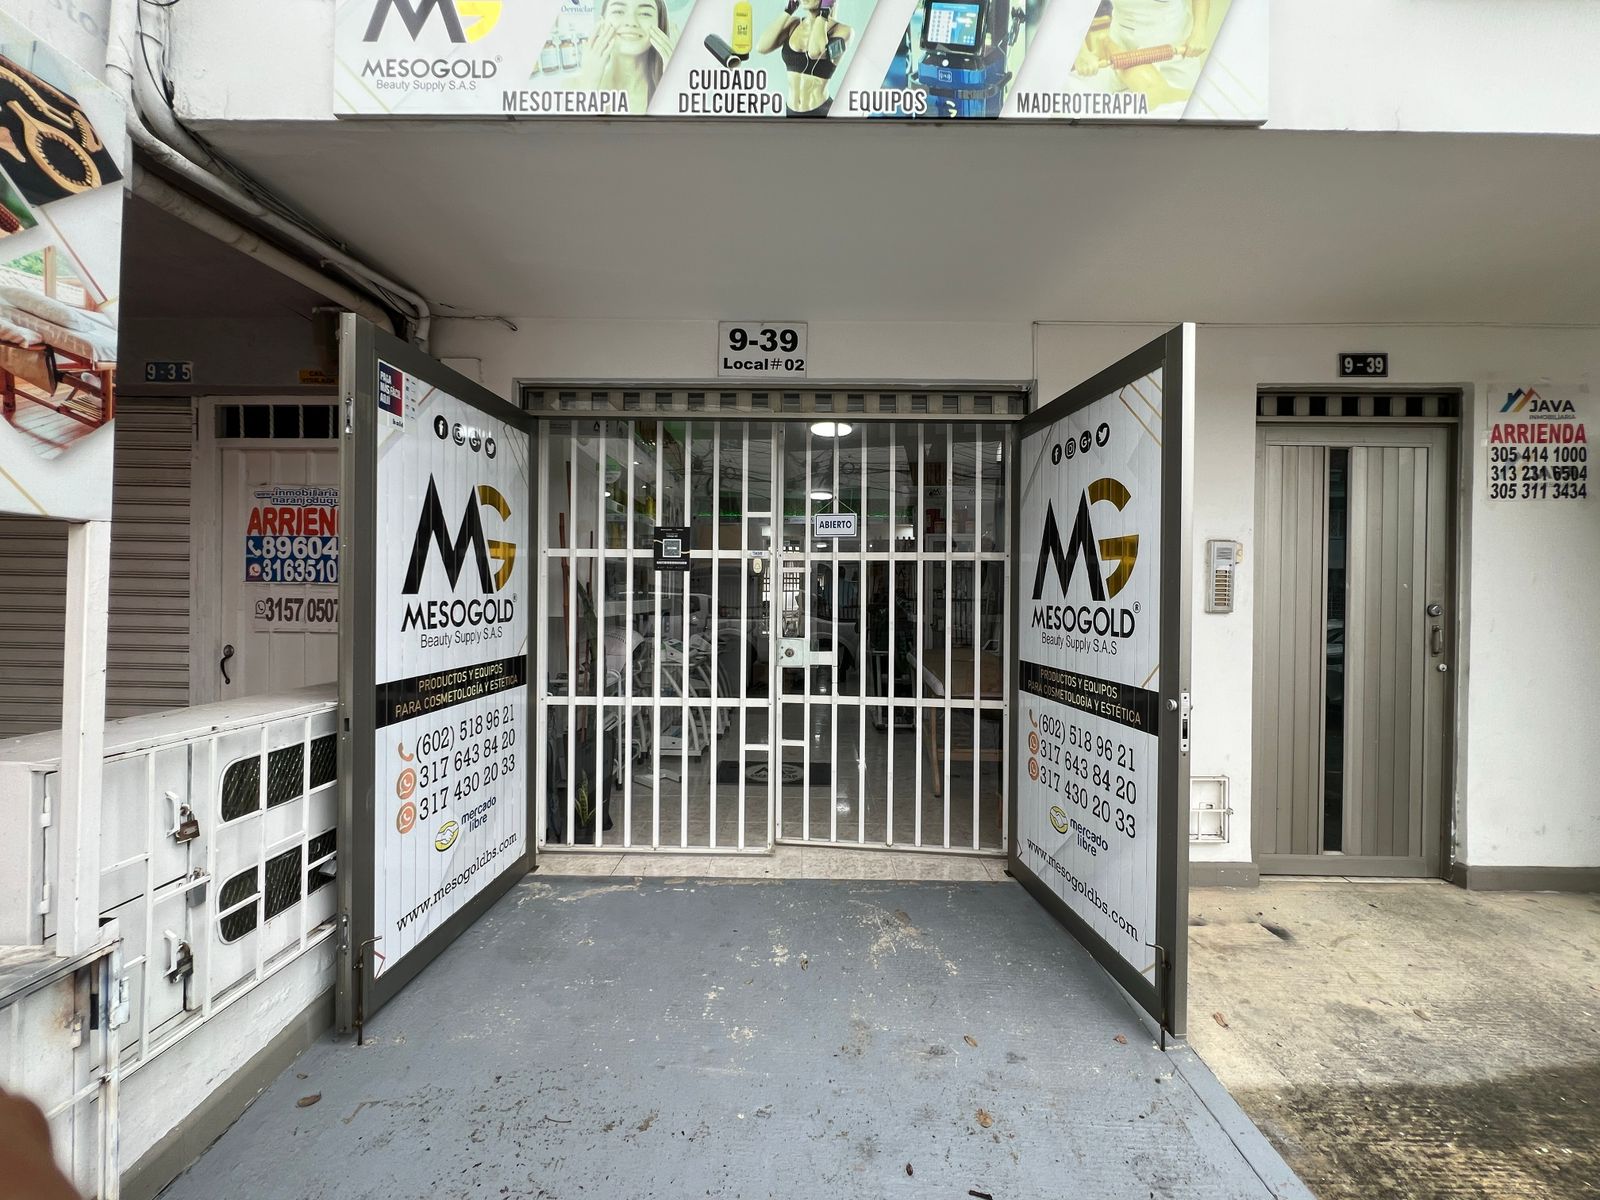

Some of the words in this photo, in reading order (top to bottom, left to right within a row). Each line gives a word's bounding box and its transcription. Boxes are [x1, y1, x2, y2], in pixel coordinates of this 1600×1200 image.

[376, 80, 410, 92] Beauty
[413, 80, 446, 92] Supply
[689, 70, 767, 90] CUIDADO
[502, 91, 629, 113] MESOTERAPIA
[849, 91, 926, 113] EQUIPOS
[1017, 93, 1148, 115] MADEROTERAPIA
[729, 328, 799, 352] 9-39
[1529, 400, 1576, 412] JAVA
[1490, 423, 1587, 444] ARRIENDA
[1490, 446, 1517, 462] 305
[1522, 446, 1549, 462] 414
[1553, 446, 1587, 462] 1000
[1491, 465, 1517, 481] 313
[1521, 465, 1547, 481] 231
[1552, 465, 1587, 481] 6504
[1490, 483, 1517, 499] 305
[1521, 483, 1547, 499] 311
[1552, 483, 1587, 499] 3434
[247, 507, 339, 536] ARRIEN
[819, 519, 852, 530] ABIERTO
[420, 631, 453, 649] Beauty
[454, 628, 482, 645] Supply
[1041, 632, 1064, 650] Beauty
[1065, 635, 1091, 653] Supply
[418, 671, 467, 692] PRODUCTOS
[469, 669, 475, 680] Y
[474, 663, 503, 680] EQUIPOS
[1040, 668, 1077, 687] PRODUCTOS
[1077, 678, 1083, 688] Y
[1083, 680, 1118, 699] EQUIPOS
[395, 700, 422, 718] PARA
[424, 681, 484, 709] COSMETOLOGÍA
[484, 682, 489, 692] Y
[1027, 680, 1043, 692] PARA
[1043, 684, 1093, 709] COSMETOLOGÍA
[1094, 700, 1100, 711] Y
[1100, 701, 1142, 725] ESTÉTICA
[416, 726, 455, 763] (602)
[460, 715, 483, 741] 518
[486, 708, 500, 731] 96
[502, 704, 515, 724] 21
[1038, 713, 1066, 745] (602)
[1069, 725, 1092, 752] 518
[1096, 735, 1113, 761] 96
[1117, 744, 1136, 772] 21
[419, 757, 449, 788] 317
[454, 743, 480, 771] 643
[483, 738, 498, 758] 84
[502, 728, 516, 749] 20
[1040, 740, 1061, 767] 317
[1064, 751, 1089, 780] 643
[1092, 764, 1111, 791] 84
[1116, 775, 1137, 805] 20
[419, 786, 449, 821] 317
[454, 772, 480, 801] 430
[483, 763, 498, 784] 20
[502, 754, 516, 776] 33
[461, 796, 497, 825] mercado
[1040, 765, 1061, 793] 317
[1064, 779, 1088, 809] 430
[1092, 795, 1111, 823] 20
[1115, 808, 1136, 839] 33
[469, 813, 488, 833] libre
[1070, 817, 1109, 852] mercado
[1077, 833, 1097, 857] libre
[396, 831, 518, 932] www.mesogoldbs.com
[1026, 838, 1139, 942] www.mesogoldbs.com
